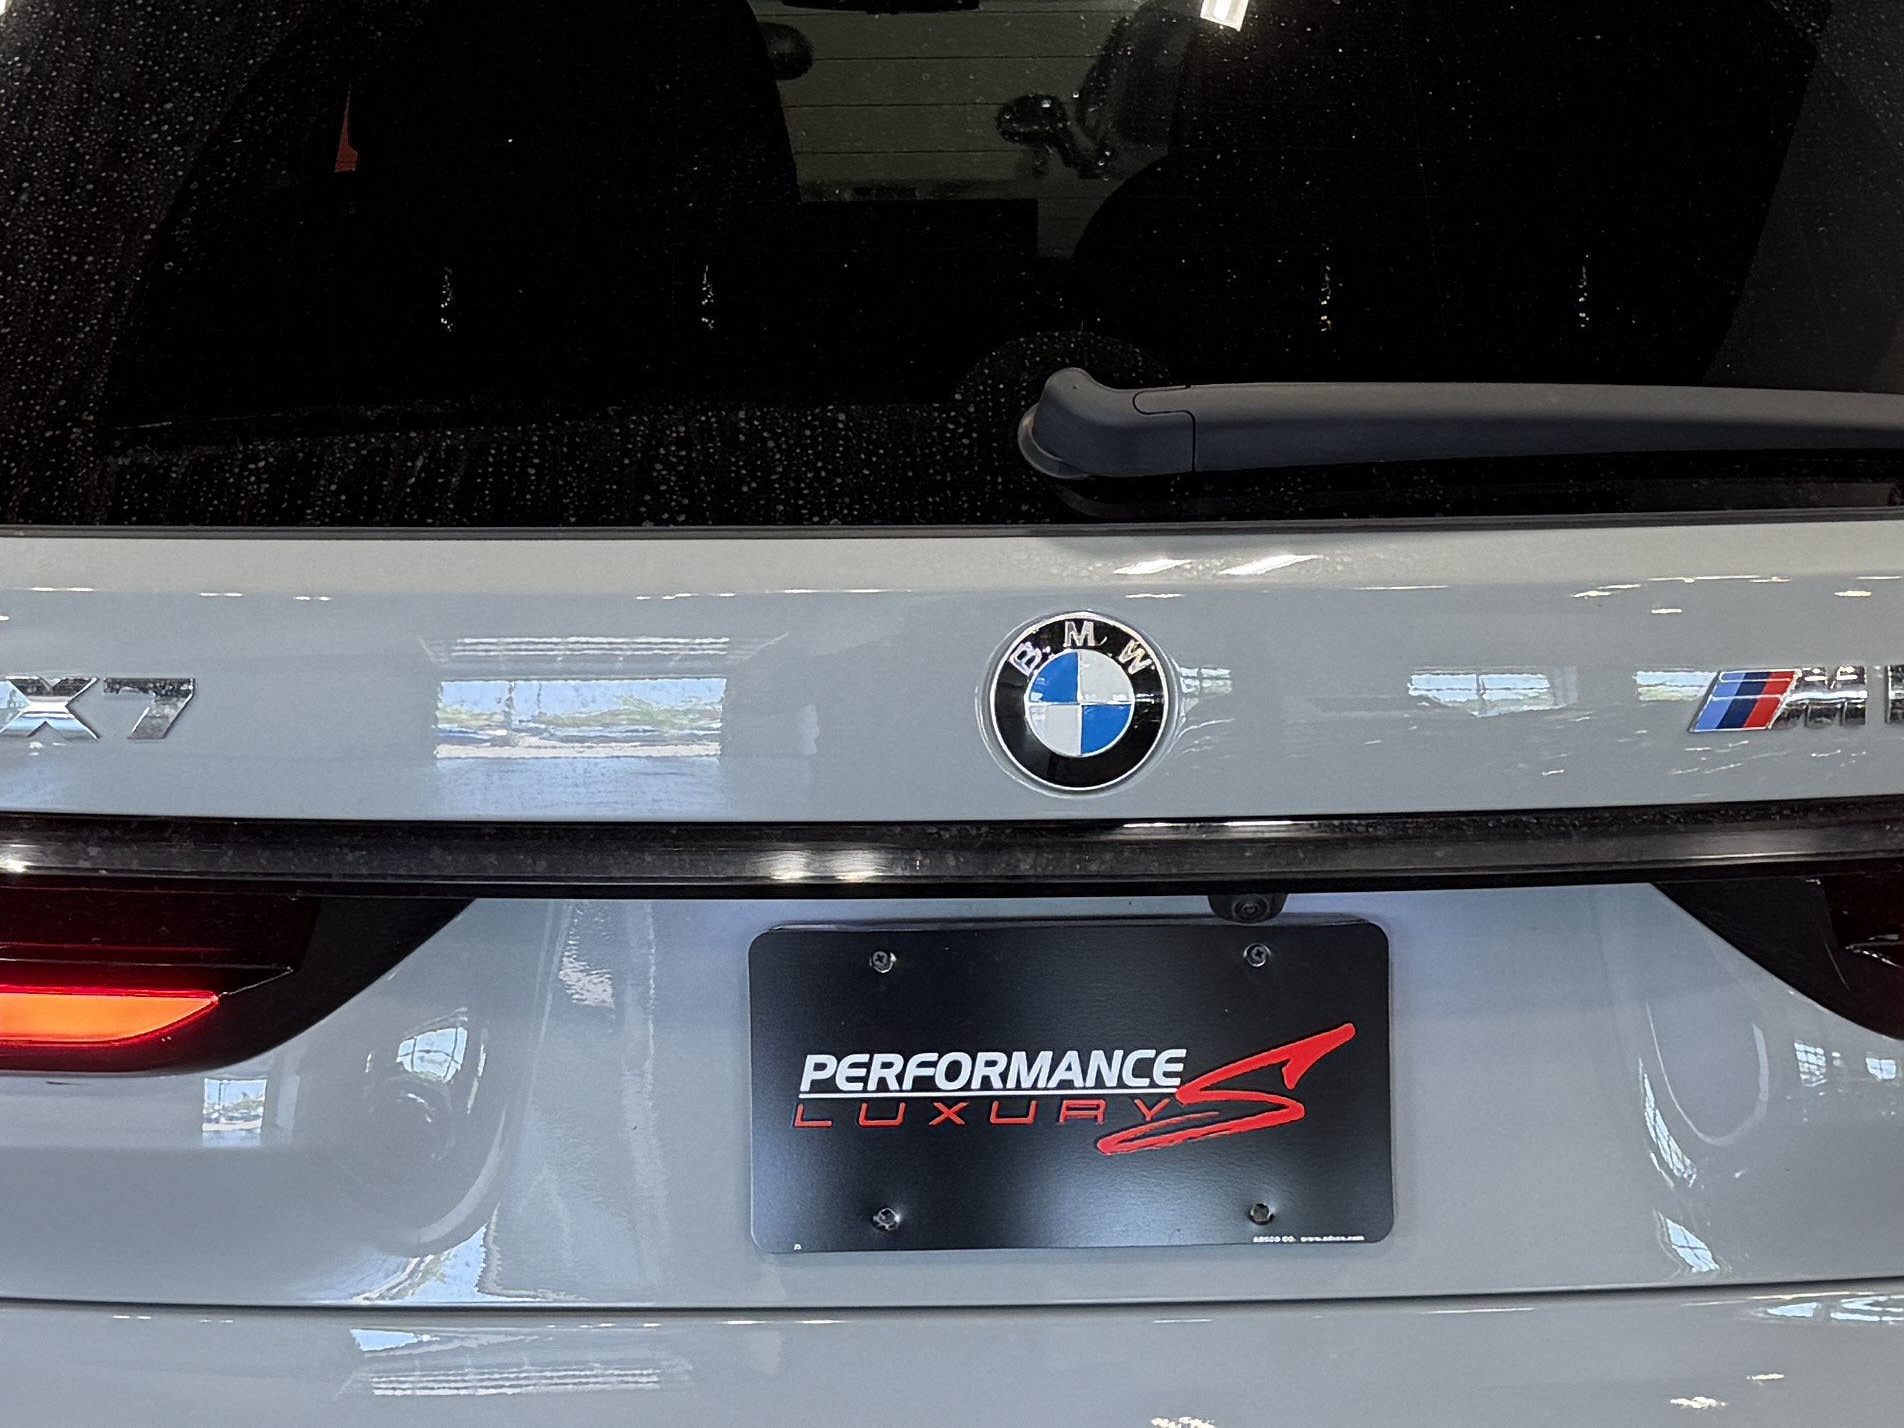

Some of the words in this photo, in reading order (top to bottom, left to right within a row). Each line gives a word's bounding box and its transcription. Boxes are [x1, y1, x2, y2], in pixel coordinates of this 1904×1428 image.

[1009, 620, 1152, 676] BMW
[799, 1049, 1187, 1092] PERFORMANCE
[793, 1098, 1172, 1128] LUXURY
